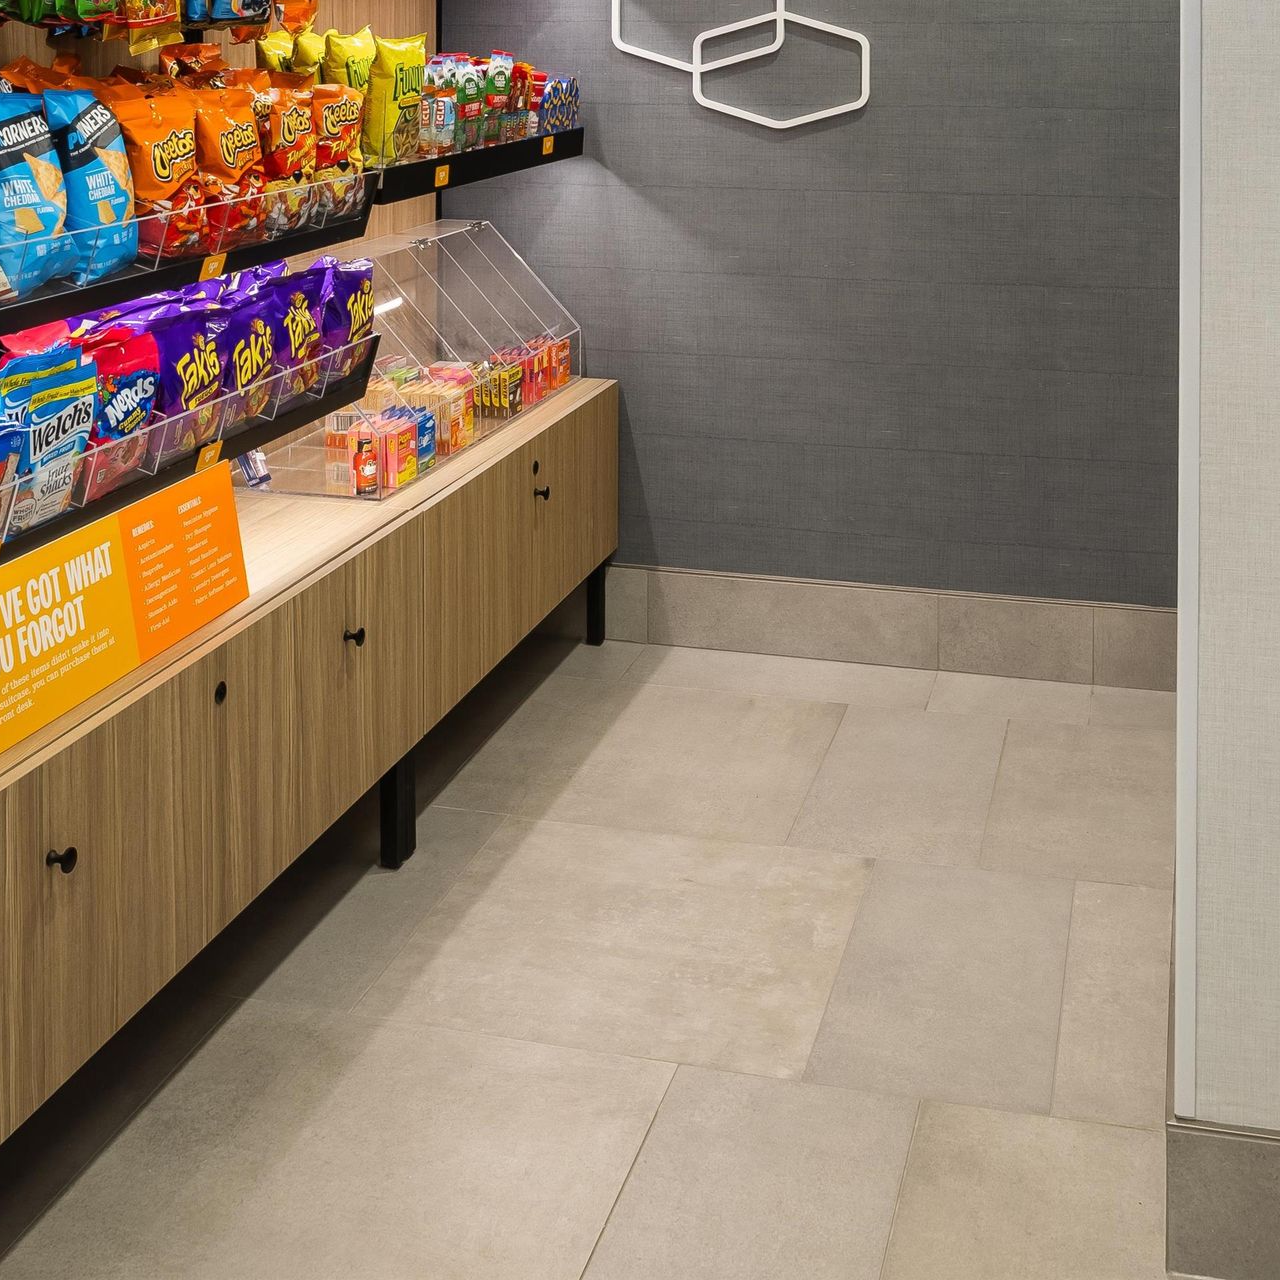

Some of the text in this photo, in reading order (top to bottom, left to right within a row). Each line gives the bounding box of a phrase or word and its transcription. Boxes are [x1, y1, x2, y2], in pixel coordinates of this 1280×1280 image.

[2, 180, 35, 196] WHITE
[4, 192, 41, 207] CHEDDAR
[86, 172, 113, 190] WHITE
[88, 186, 116, 200] CHEDDAR
[347, 288, 374, 341] Takis
[176, 340, 220, 410] Takis
[233, 325, 273, 396] Takis
[32, 401, 92, 457] Welch's
[138, 539, 156, 551] Aspirin
[26, 567, 62, 615] GOT
[65, 542, 112, 595] WHAT
[17, 596, 86, 664] FORGOT
[1, 683, 10, 696] of
[10, 674, 30, 690] these
[31, 663, 50, 679] items
[51, 652, 70, 668] didn't
[72, 640, 90, 656] make
[97, 628, 110, 642] into
[32, 680, 45, 695] you
[46, 672, 60, 684] can
[60, 652, 91, 677] purchase
[92, 643, 108, 656] them
[108, 638, 115, 647] at
[16, 699, 35, 716] desk.
